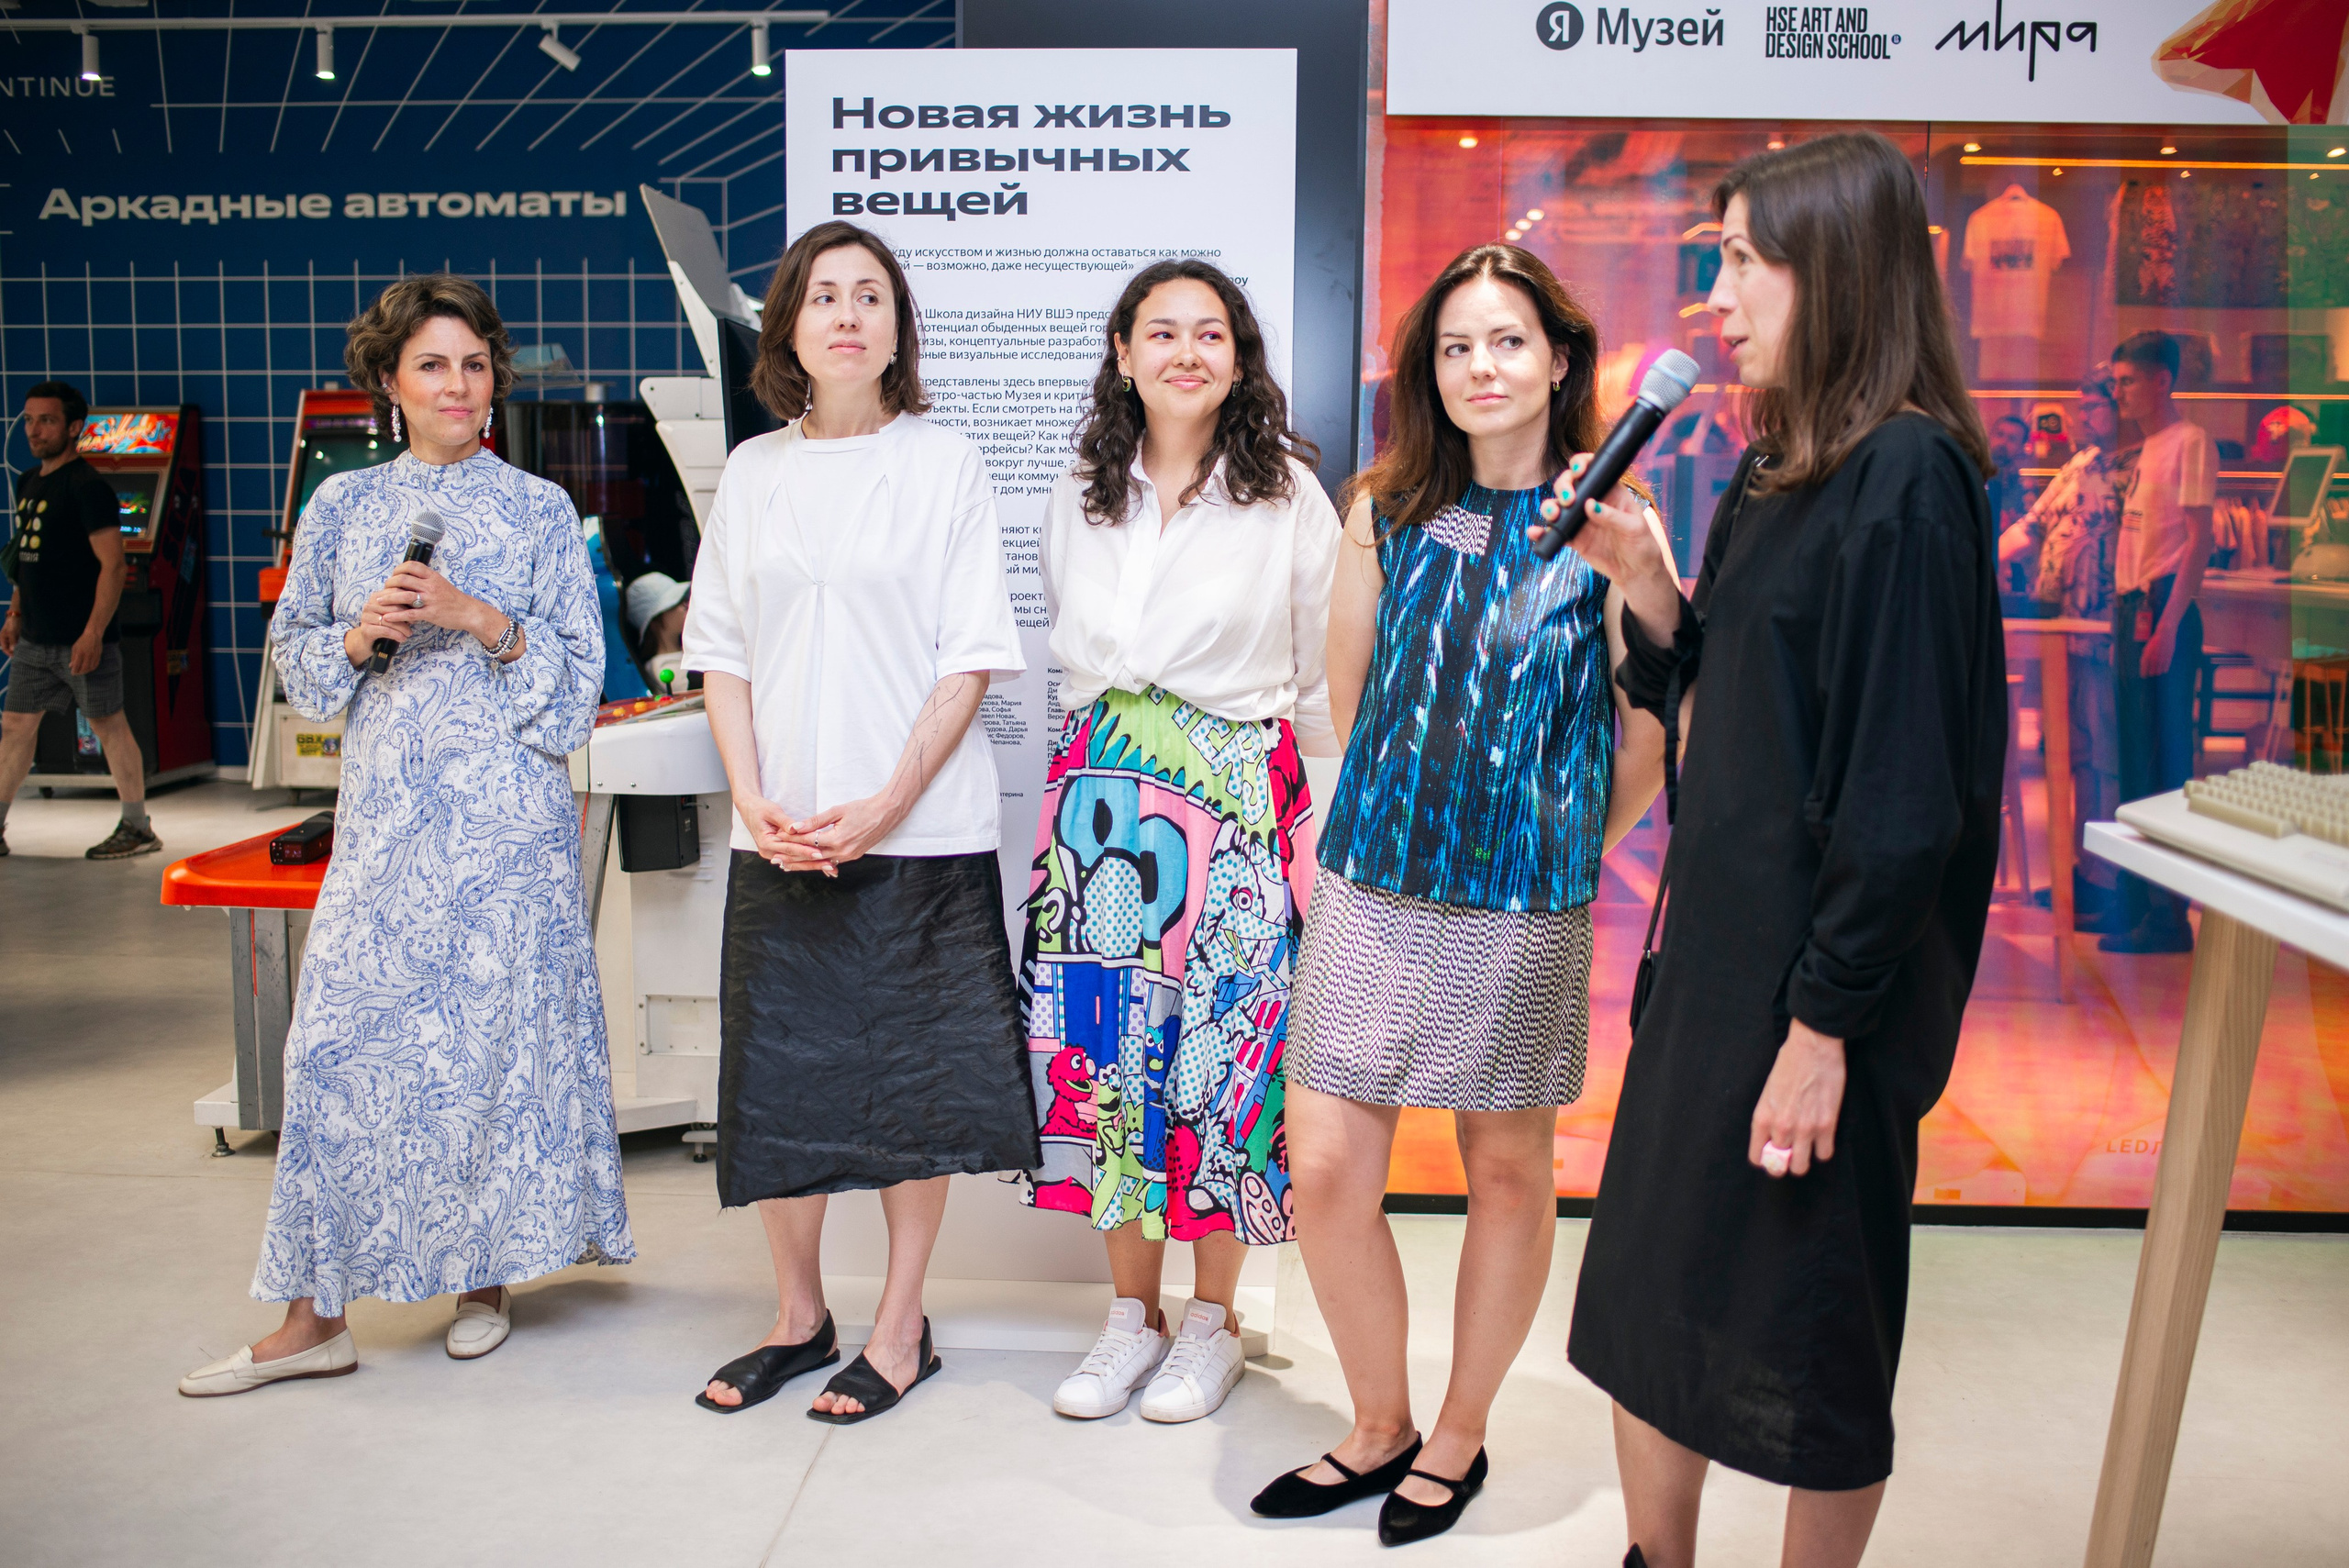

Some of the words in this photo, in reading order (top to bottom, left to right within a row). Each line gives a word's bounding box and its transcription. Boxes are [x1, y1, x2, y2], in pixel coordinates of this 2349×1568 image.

[1766, 6, 1798, 32] HSE
[1800, 7, 1832, 32] ART
[1835, 7, 1867, 33] AND
[1597, 7, 1723, 53] Музей
[1765, 33, 1823, 59] DESIGN
[1827, 33, 1890, 60] SCHOOL
[833, 97, 1019, 128] Новая
[1033, 105, 1231, 128] жизнь
[833, 147, 1191, 179] привычных
[39, 186, 331, 227] Аркадные
[344, 189, 628, 219] автоматы
[833, 183, 1029, 221] вещей
[916, 249, 982, 259] искусством
[986, 249, 992, 257] и
[996, 249, 1041, 257] жизнью
[1044, 249, 1088, 259] должна
[1092, 249, 1155, 258] оставаться
[1158, 249, 1178, 258] как
[1181, 249, 1221, 258] можно
[927, 262, 988, 272] возможно,
[991, 262, 1021, 272] даже
[1025, 261, 1136, 272] несуществующей»
[926, 308, 963, 319] Школа
[965, 308, 1013, 320] дизайна
[1017, 308, 1042, 319] НИУ
[1046, 308, 1074, 319] ВШЭ
[981, 322, 1046, 332] обыденных
[1049, 322, 1087, 334] вещей
[950, 339, 1045, 348] концептуальные
[950, 351, 1018, 361] визуальные
[1021, 351, 1103, 361] исследования
[1004, 378, 1035, 388] здесь
[1006, 391, 1041, 402] Музея
[973, 404, 1000, 413] Если
[1002, 406, 1057, 415] смотреть
[974, 419, 1033, 428] возникает
[993, 430, 1036, 441] вещей?
[1039, 430, 1059, 440] Как
[1036, 444, 1056, 454] Как
[985, 460, 1025, 469] вокруг
[1028, 460, 1067, 469] лучше,
[989, 473, 1016, 483] ещи
[1000, 486, 1024, 495] дом
[1190, 1311, 1209, 1322] adidas
